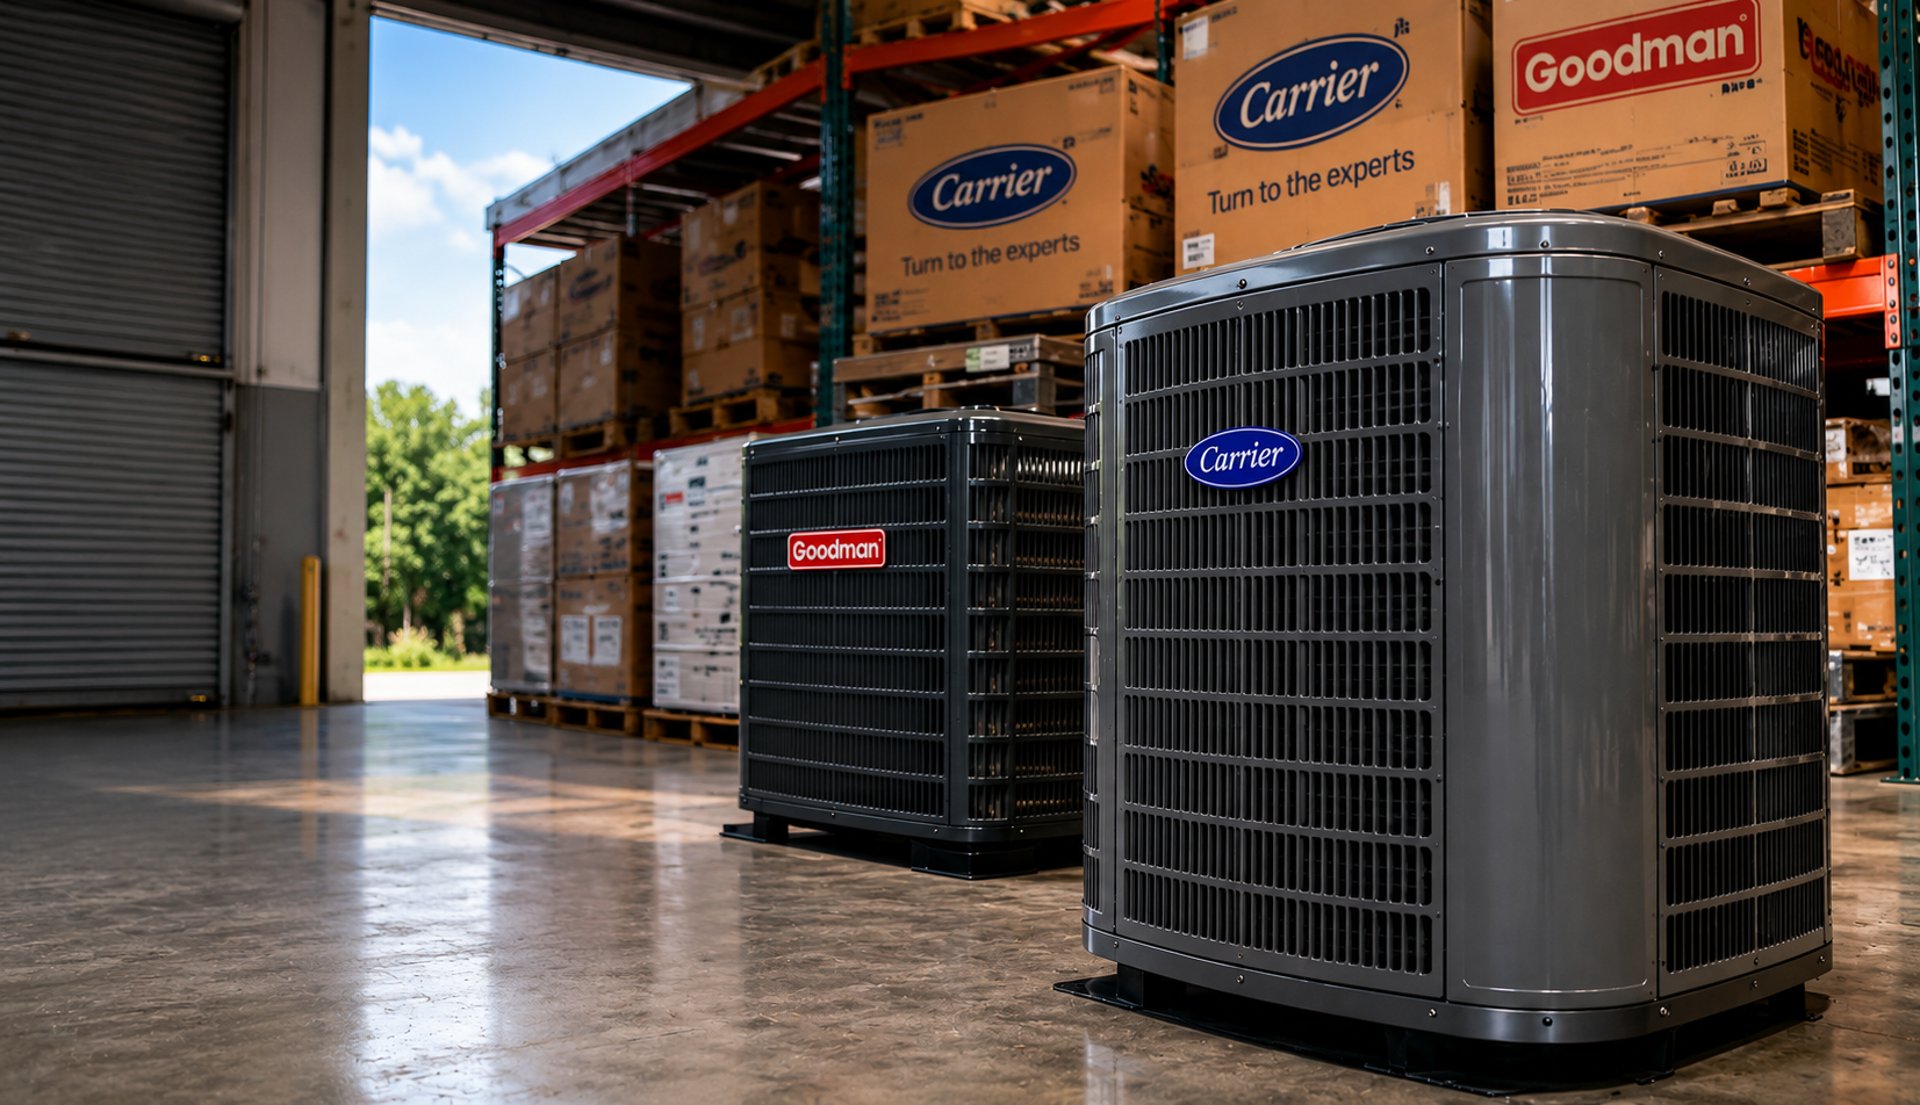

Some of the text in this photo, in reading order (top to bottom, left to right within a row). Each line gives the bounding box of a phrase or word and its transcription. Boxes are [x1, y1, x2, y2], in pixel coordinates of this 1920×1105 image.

[1525, 23, 1744, 93] Goodman
[1240, 60, 1379, 128] Carrier
[932, 162, 1052, 211] Carrier
[1208, 149, 1415, 215] Turn to the experts
[902, 233, 1080, 277] Turn to the experts
[1200, 441, 1284, 473] Carrier
[793, 538, 879, 561] Goodman
